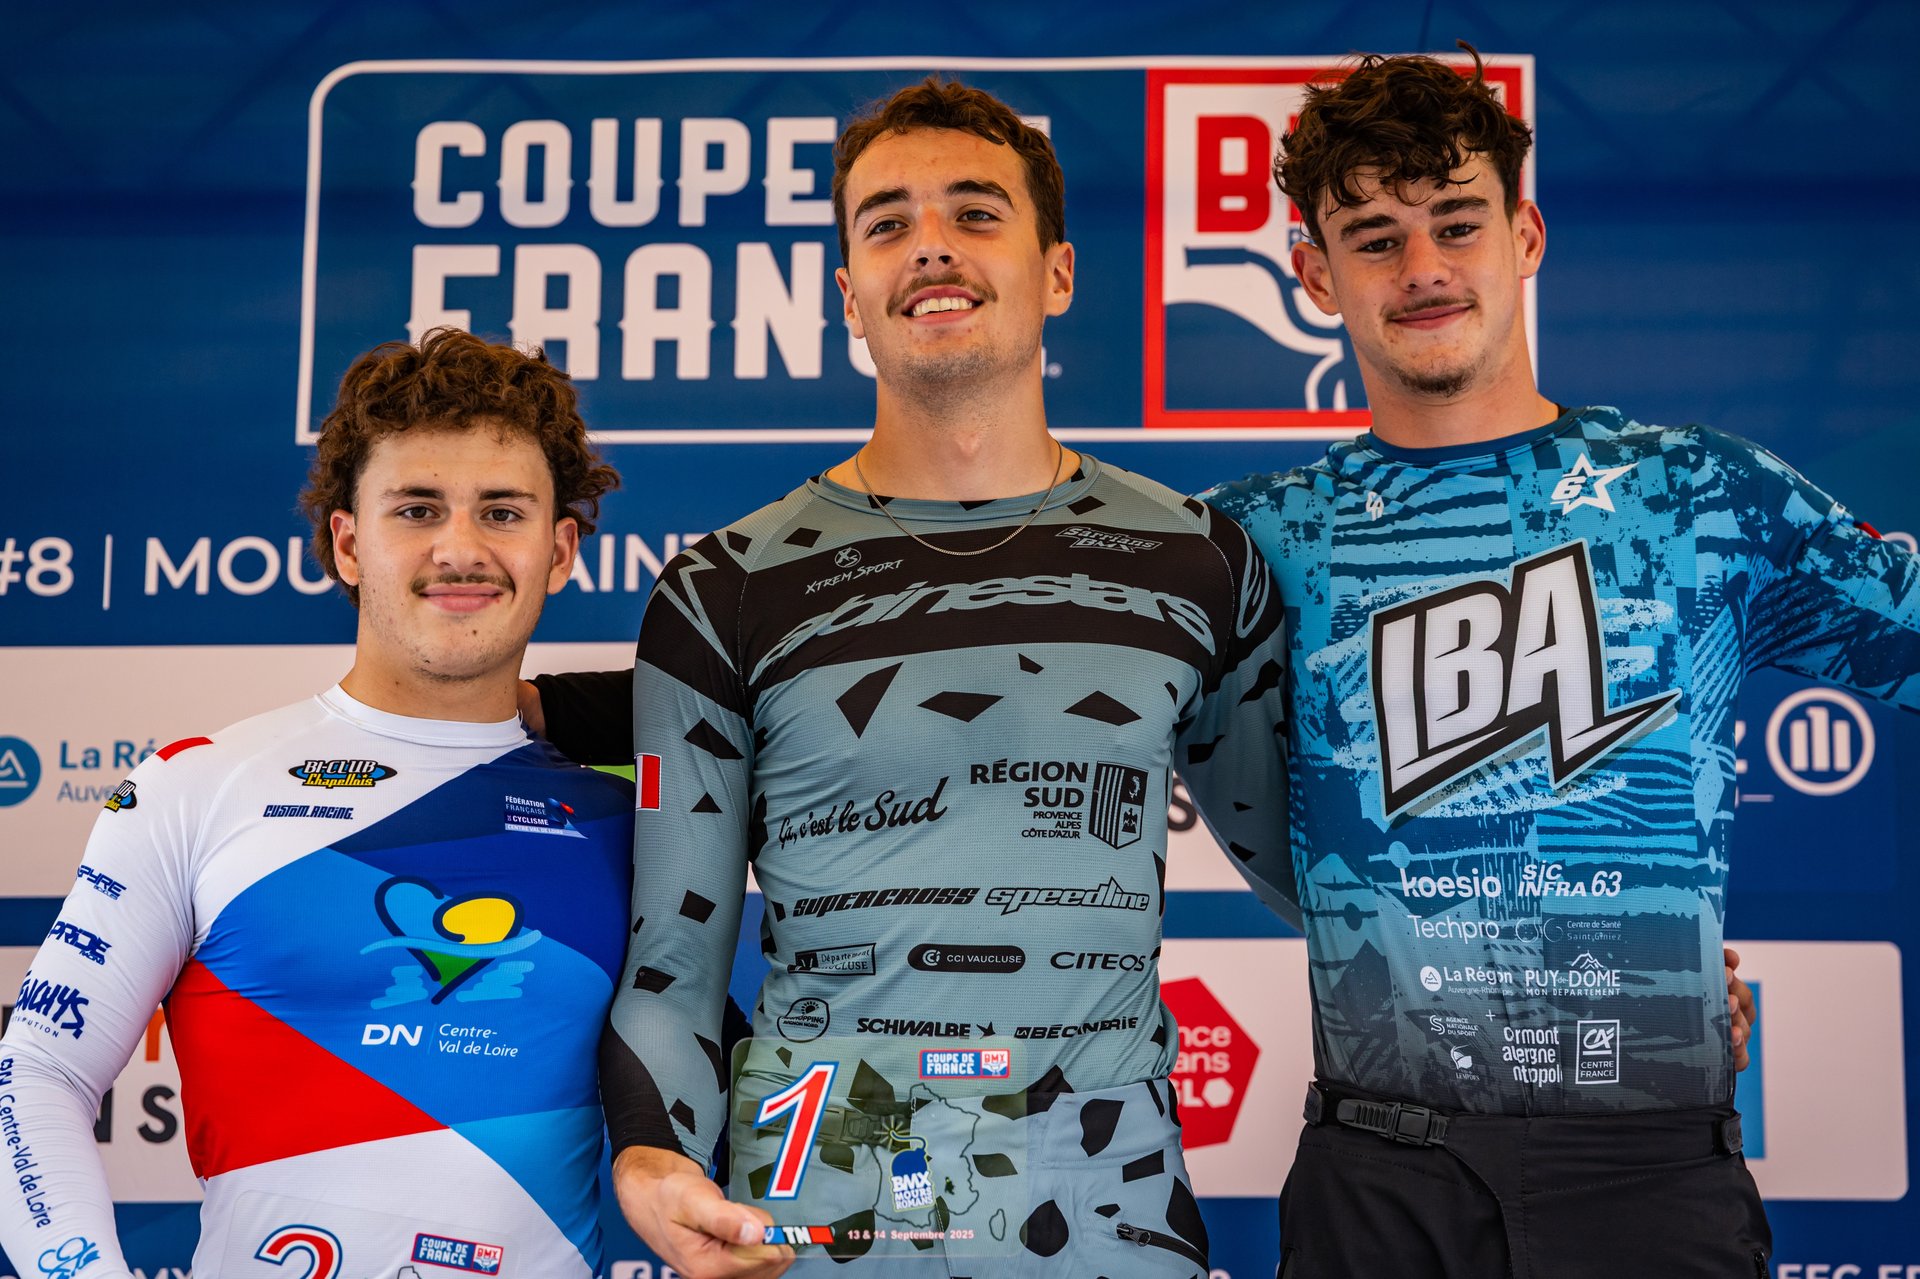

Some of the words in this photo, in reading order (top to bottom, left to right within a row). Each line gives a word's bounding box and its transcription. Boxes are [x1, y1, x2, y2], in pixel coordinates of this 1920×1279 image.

[410, 116, 837, 228] COUPE
[406, 242, 877, 380] FRAN
[1379, 553, 1660, 794] IBA
[60, 740, 101, 769] La
[303, 760, 377, 774] BI-CLUB
[970, 758, 1089, 785] RÉGION
[304, 773, 374, 788] Chapellois
[505, 795, 545, 808] FÉDÉRATION
[838, 799, 861, 833] le
[864, 775, 950, 832] Sud
[1024, 787, 1085, 808] SUD
[506, 804, 547, 815] FRANÇAISE
[1033, 811, 1082, 820] PROVENCE
[512, 815, 549, 826] CYCLISME
[1055, 821, 1082, 829] ALPES
[1021, 827, 1047, 838] CÔTE
[1400, 868, 1501, 897] koesio
[1518, 881, 1587, 897] INFRA
[1591, 870, 1623, 897] 63
[985, 876, 1150, 916] speedline
[1407, 915, 1499, 944] Techpro
[1567, 921, 1591, 929] Centre
[1592, 920, 1600, 929] de
[1601, 919, 1622, 929] Santé
[947, 954, 964, 963] CCI
[967, 955, 1022, 964] VAUCLUSE
[1050, 951, 1146, 972] CITEOS
[1444, 967, 1463, 981] La
[1526, 988, 1548, 996] MON
[361, 1024, 423, 1046] DN
[439, 1023, 498, 1038] Centre-
[857, 1017, 971, 1039] SCHWALBE
[439, 1040, 460, 1054] Val
[463, 1041, 481, 1054] de
[484, 1043, 518, 1057] Loire
[926, 1053, 959, 1063] COUPE
[961, 1053, 975, 1063] DE
[1581, 1060, 1615, 1069] CENTRE
[926, 1063, 975, 1075] FRANCE
[1581, 1069, 1615, 1078] FRANCE
[752, 1061, 838, 1200] 1
[891, 1171, 932, 1193] BMX
[894, 1186, 933, 1202] MOURS
[26, 1191, 52, 1228] Loire
[782, 1226, 813, 1244] TN
[848, 1230, 860, 1240] 13
[862, 1230, 871, 1240] &
[874, 1230, 886, 1240] 14
[890, 1230, 945, 1242] Septembre
[950, 1230, 974, 1240] 2025
[421, 1237, 453, 1252] COUPE
[455, 1241, 468, 1254] DE
[419, 1247, 466, 1267] FRANCE
